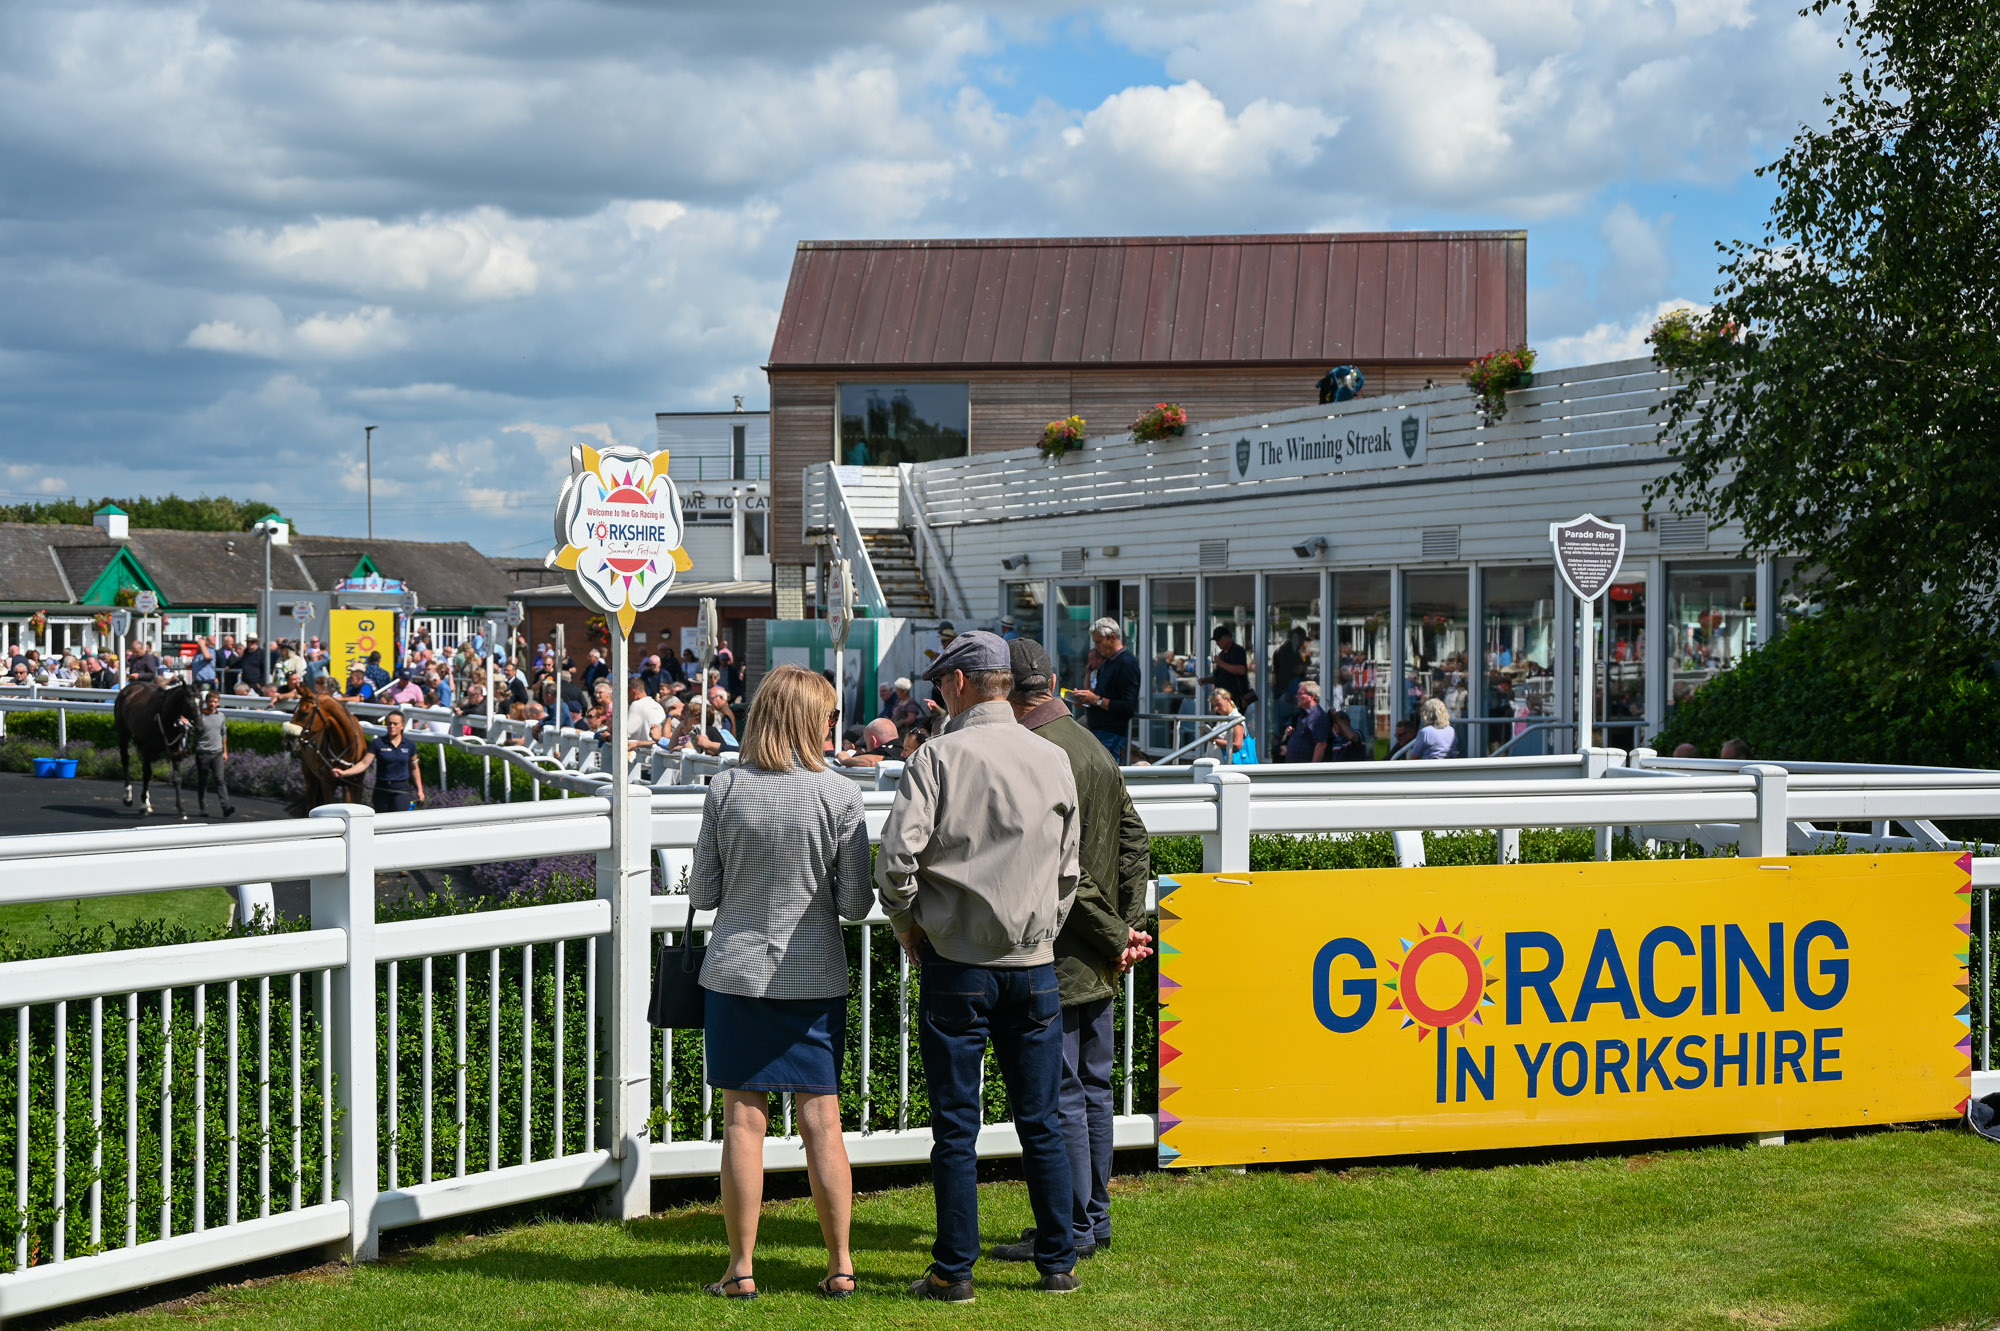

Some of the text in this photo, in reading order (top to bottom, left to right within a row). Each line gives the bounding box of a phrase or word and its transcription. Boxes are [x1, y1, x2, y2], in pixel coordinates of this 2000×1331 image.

[1259, 440, 1282, 466] The
[1286, 434, 1342, 464] Winning
[1346, 426, 1392, 456] Streak
[715, 496, 734, 509] TO
[587, 508, 613, 517] Welcome
[631, 510, 638, 518] Go
[640, 510, 658, 520] Racing
[586, 522, 665, 542] YORKSHIRE
[1596, 531, 1614, 540] Ring
[608, 543, 660, 556] Summer Festival
[1312, 920, 1850, 1034] GO RACING
[1436, 1027, 1844, 1104] IN YORKSHIRE
